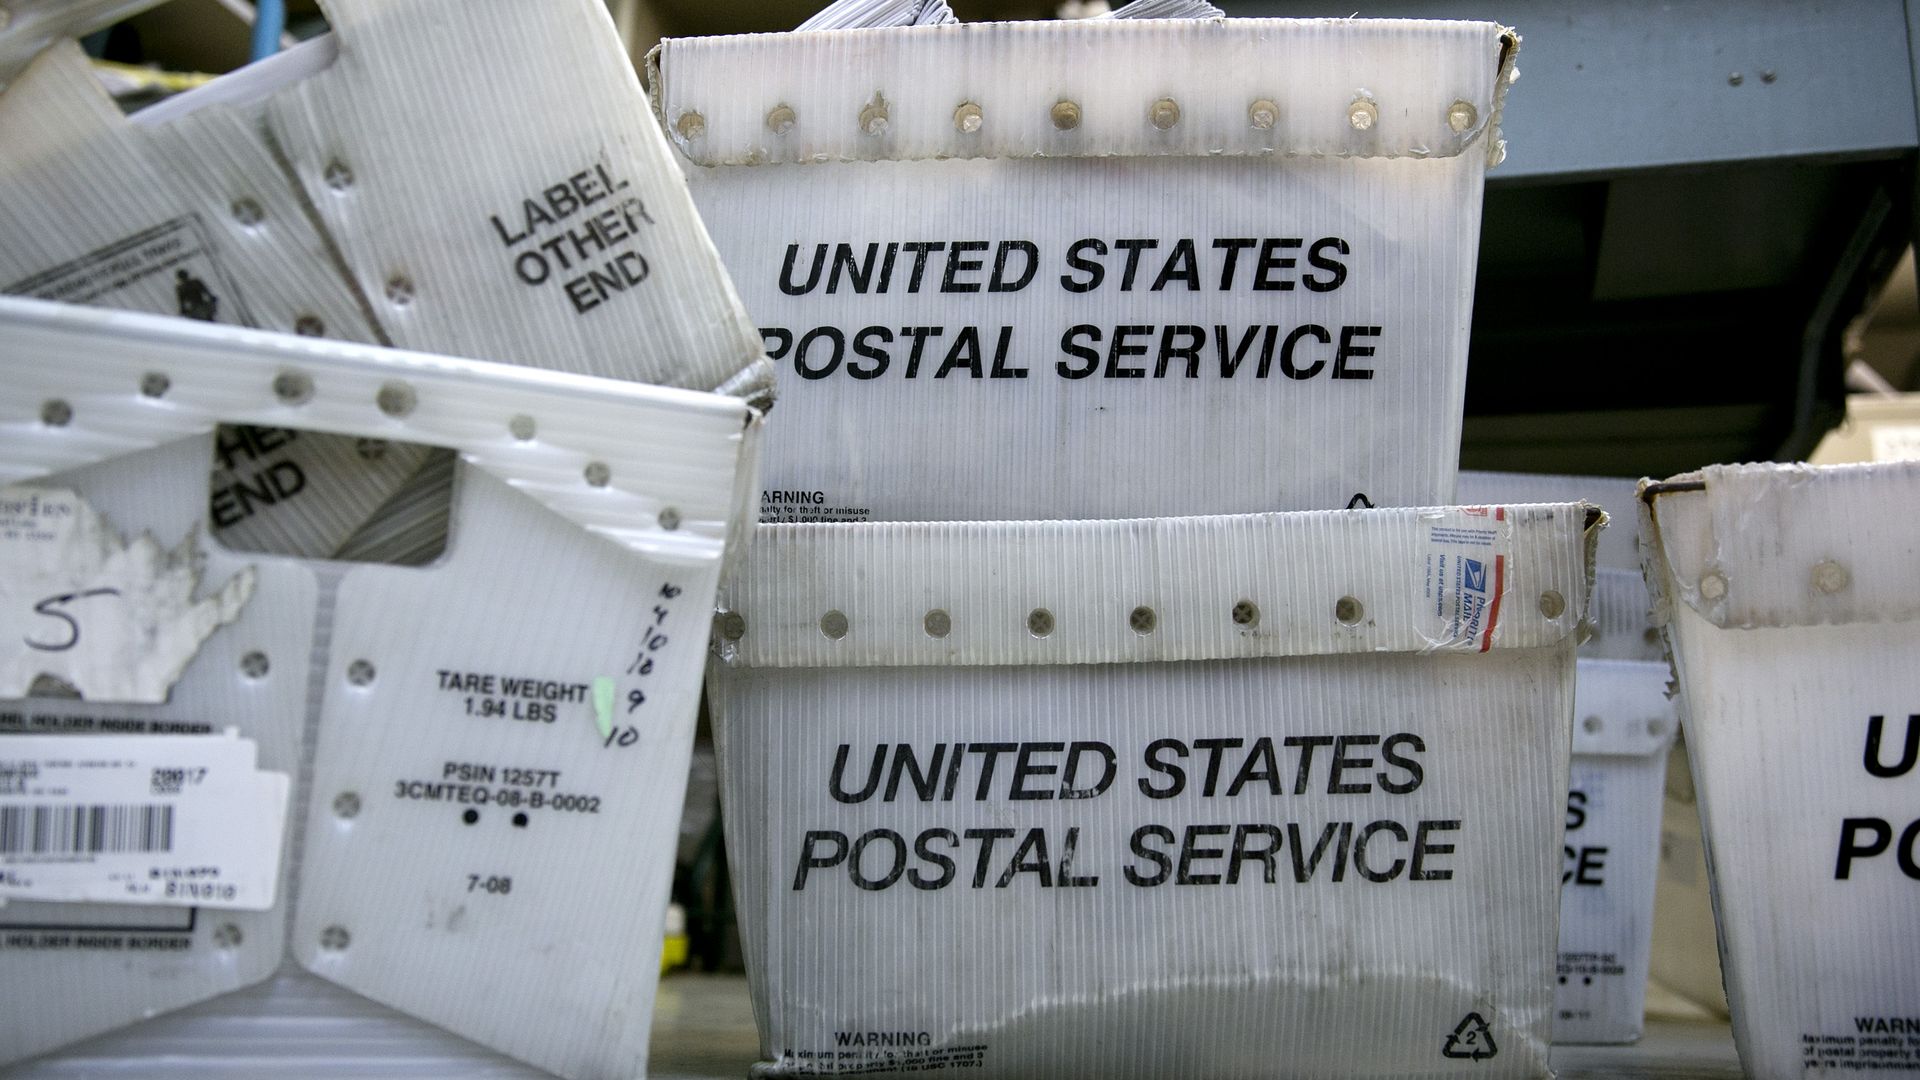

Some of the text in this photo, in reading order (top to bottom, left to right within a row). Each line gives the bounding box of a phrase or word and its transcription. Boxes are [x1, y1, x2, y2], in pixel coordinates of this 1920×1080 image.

[490, 163, 629, 248] LABEL
[515, 198, 655, 286] OTHER
[563, 250, 649, 314] END
[778, 237, 1350, 295] UNITED STATES
[757, 324, 1382, 380] POSTAL SERVICE
[211, 459, 306, 529] END
[23, 586, 121, 651] 5
[654, 604, 669, 625] 4
[1463, 592, 1473, 621] MAIL
[640, 626, 668, 651] 10
[436, 669, 589, 704] TARE WEIGHT
[627, 689, 646, 714] 9
[465, 697, 558, 724] 1.94 LBS
[603, 726, 640, 749] 10
[443, 762, 562, 789] PSIN 1257T
[829, 733, 1427, 804] UNITED STATES
[793, 820, 1462, 891] POSTAL SERVICE
[467, 874, 513, 895] 7-08
[835, 1031, 931, 1047] WARNING
[1466, 1031, 1477, 1045] 2
